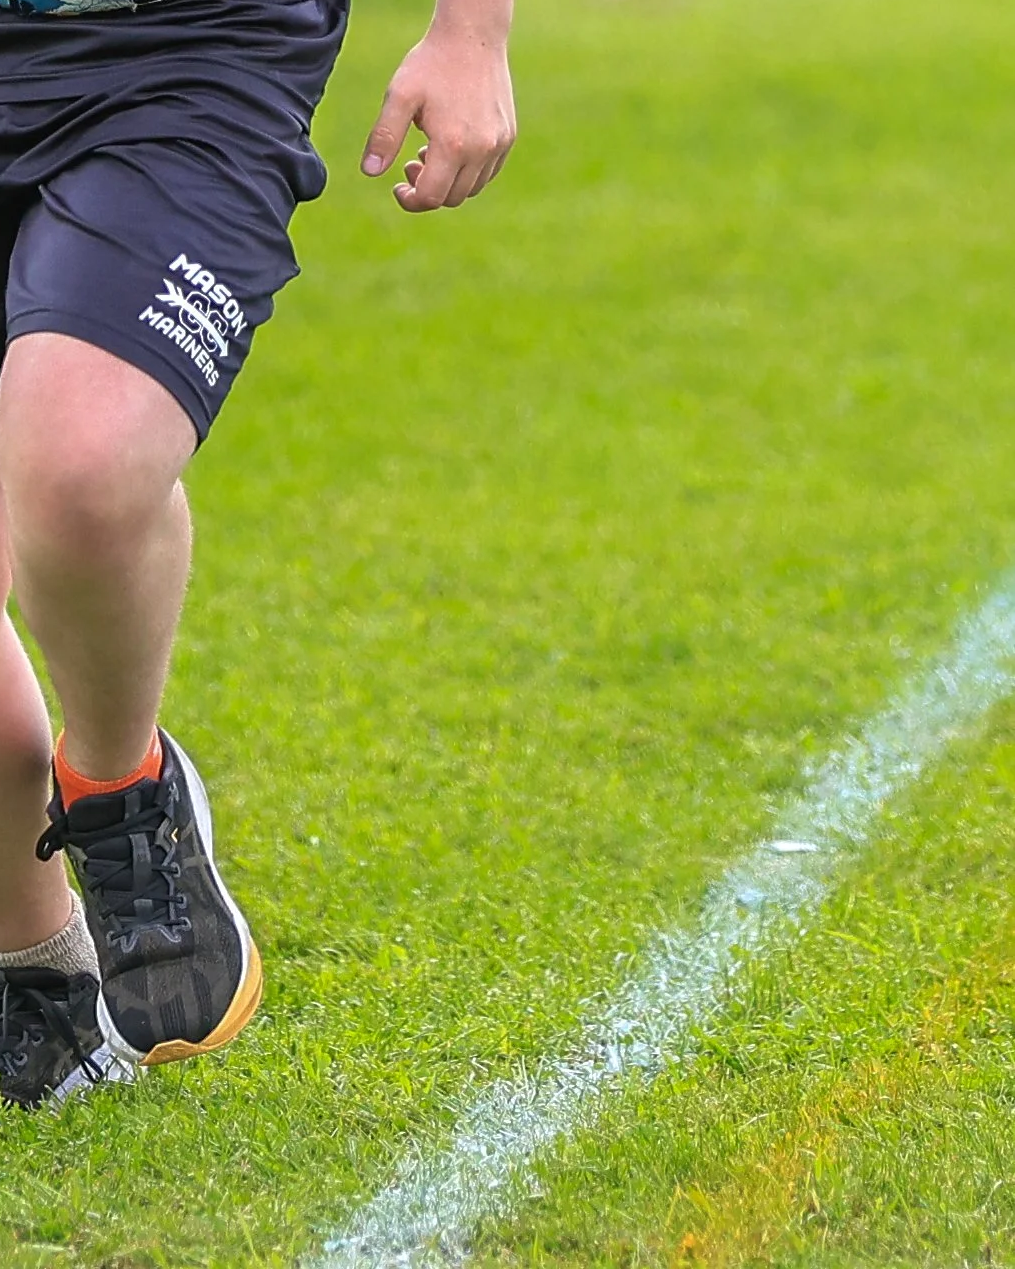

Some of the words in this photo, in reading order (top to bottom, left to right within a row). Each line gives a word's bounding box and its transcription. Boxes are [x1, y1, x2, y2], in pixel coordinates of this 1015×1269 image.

[169, 253, 248, 337] MASON
[178, 291, 229, 353] CC
[138, 305, 220, 387] MARINERS
